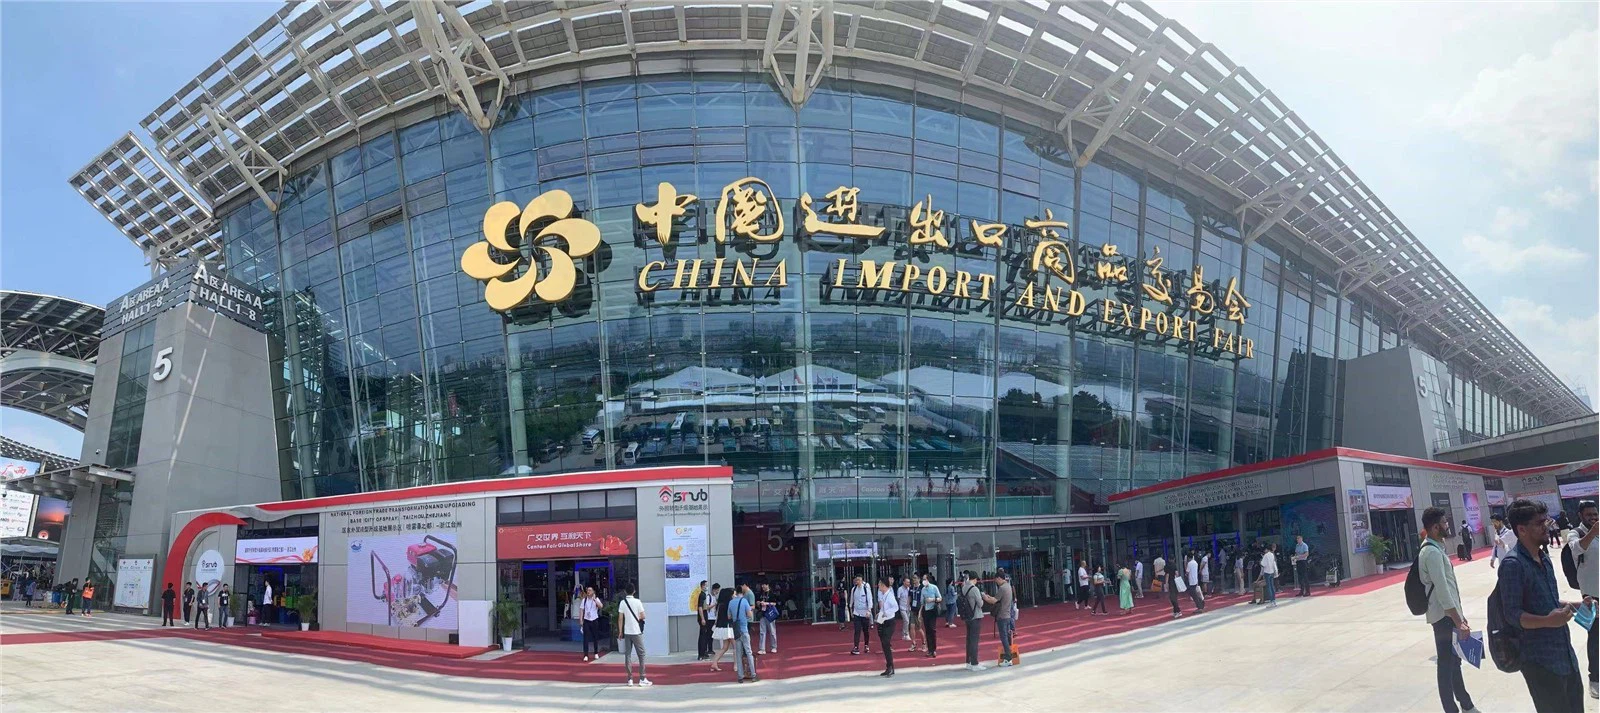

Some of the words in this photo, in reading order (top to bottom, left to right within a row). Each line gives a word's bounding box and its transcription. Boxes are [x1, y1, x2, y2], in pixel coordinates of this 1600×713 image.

[638, 257, 788, 292] CHINA
[832, 258, 996, 302] IMPORT
[1016, 281, 1087, 317] AND
[1103, 298, 1198, 342] EXPORT
[1213, 327, 1254, 360] FAIR
[152, 346, 173, 382] 5
[1418, 375, 1429, 398] 5
